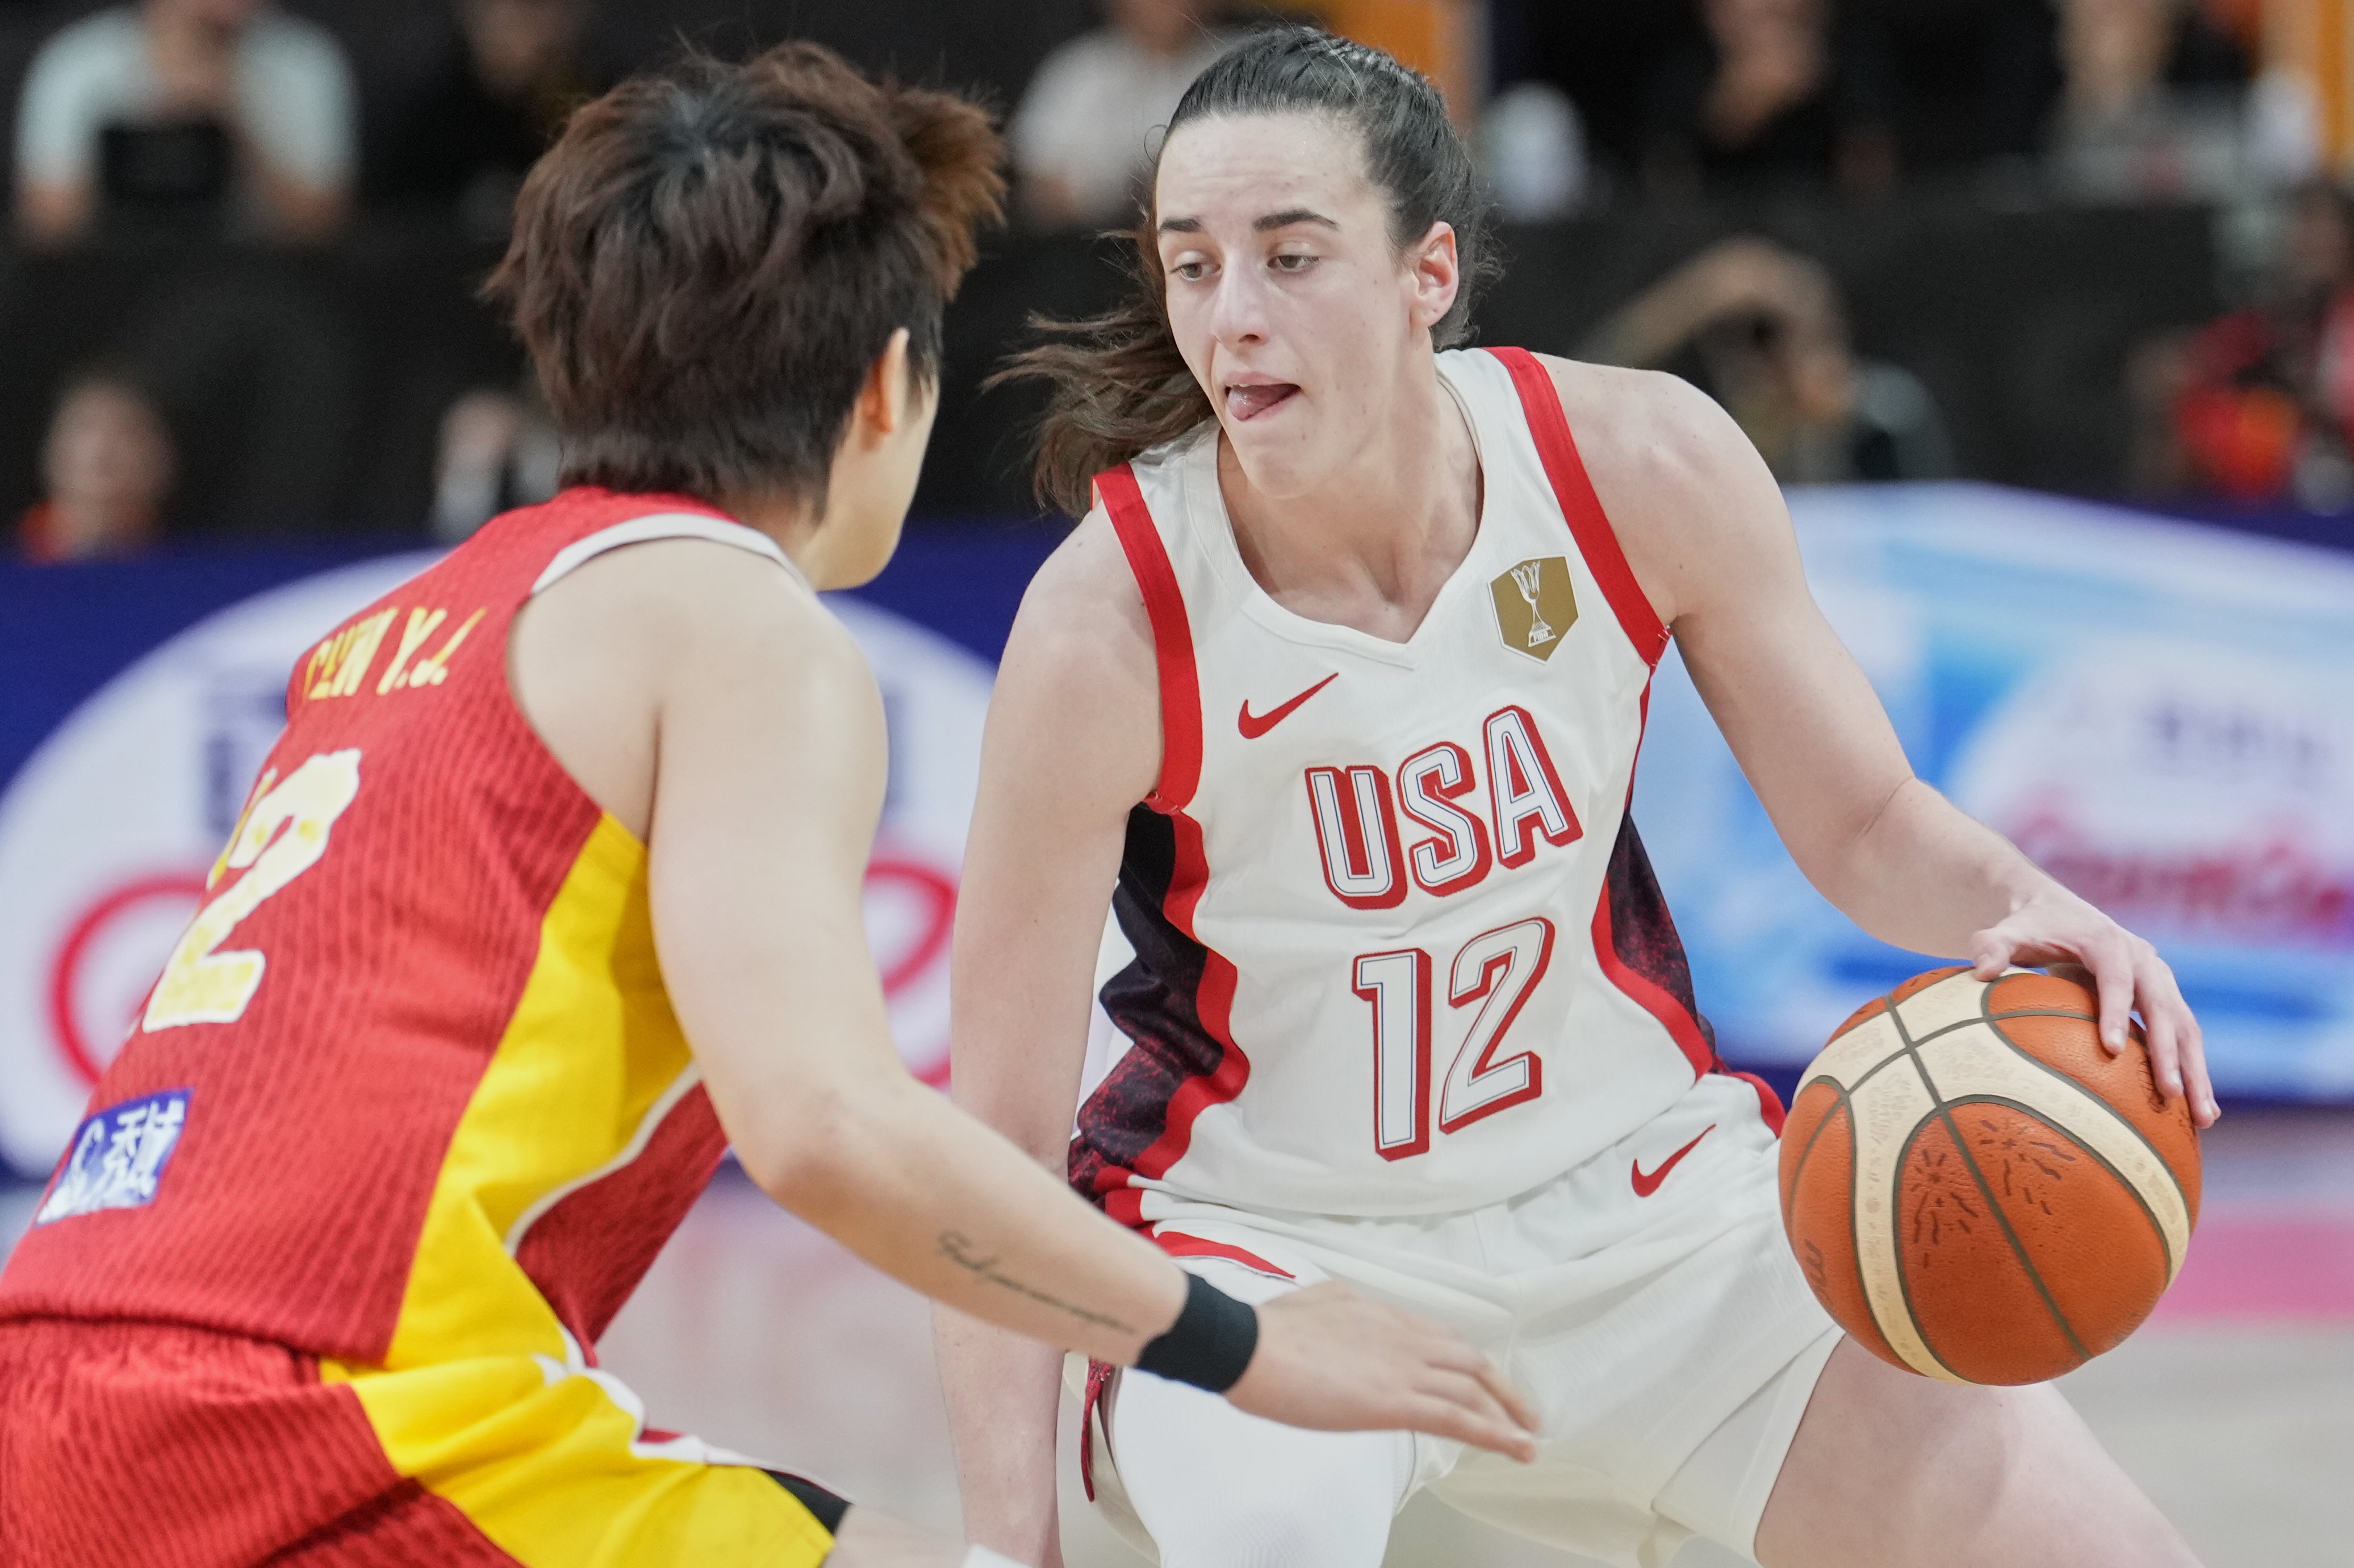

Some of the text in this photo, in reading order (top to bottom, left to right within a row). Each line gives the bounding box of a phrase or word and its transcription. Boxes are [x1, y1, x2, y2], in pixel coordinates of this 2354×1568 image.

[141, 747, 362, 1033] 2
[1305, 705, 1583, 910] USA
[1352, 917, 1555, 1161] 12
